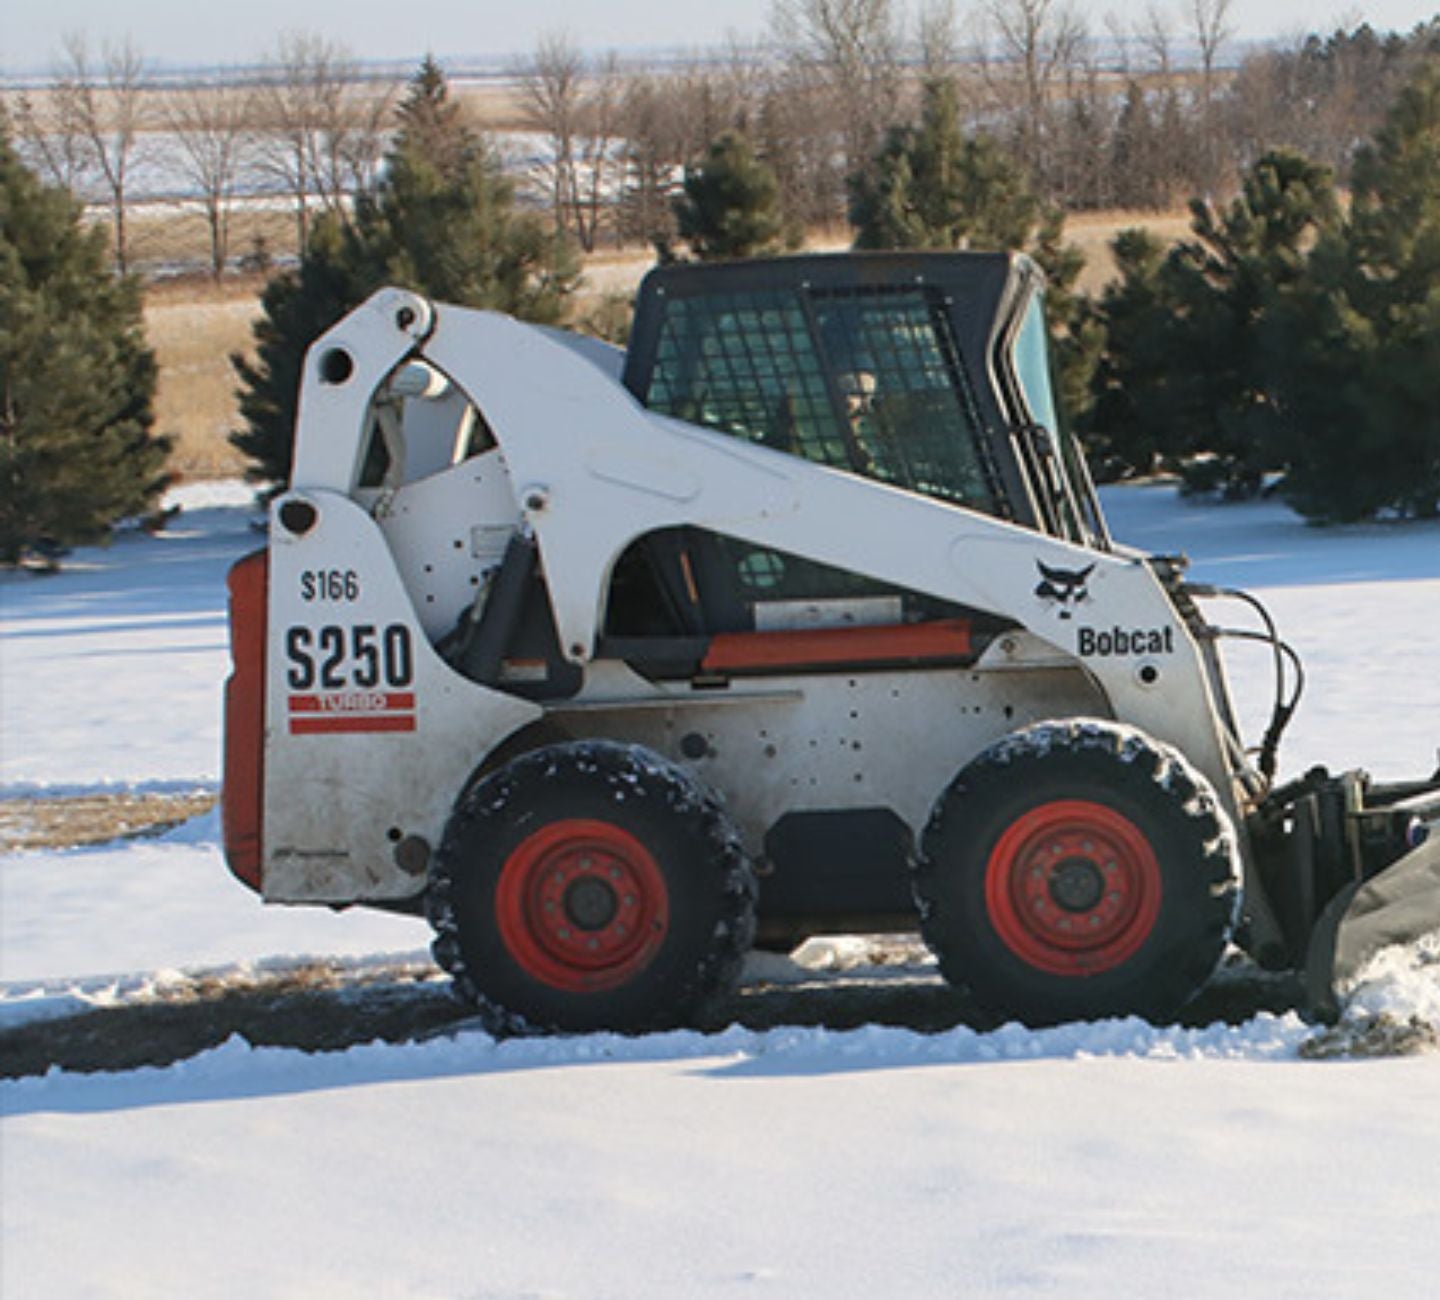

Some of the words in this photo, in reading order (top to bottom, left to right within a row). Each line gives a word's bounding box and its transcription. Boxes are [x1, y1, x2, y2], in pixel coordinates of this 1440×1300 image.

[301, 570, 359, 601] S166
[286, 623, 413, 690] S250
[1078, 625, 1173, 657] Bobcat
[317, 692, 388, 711] TURBO
